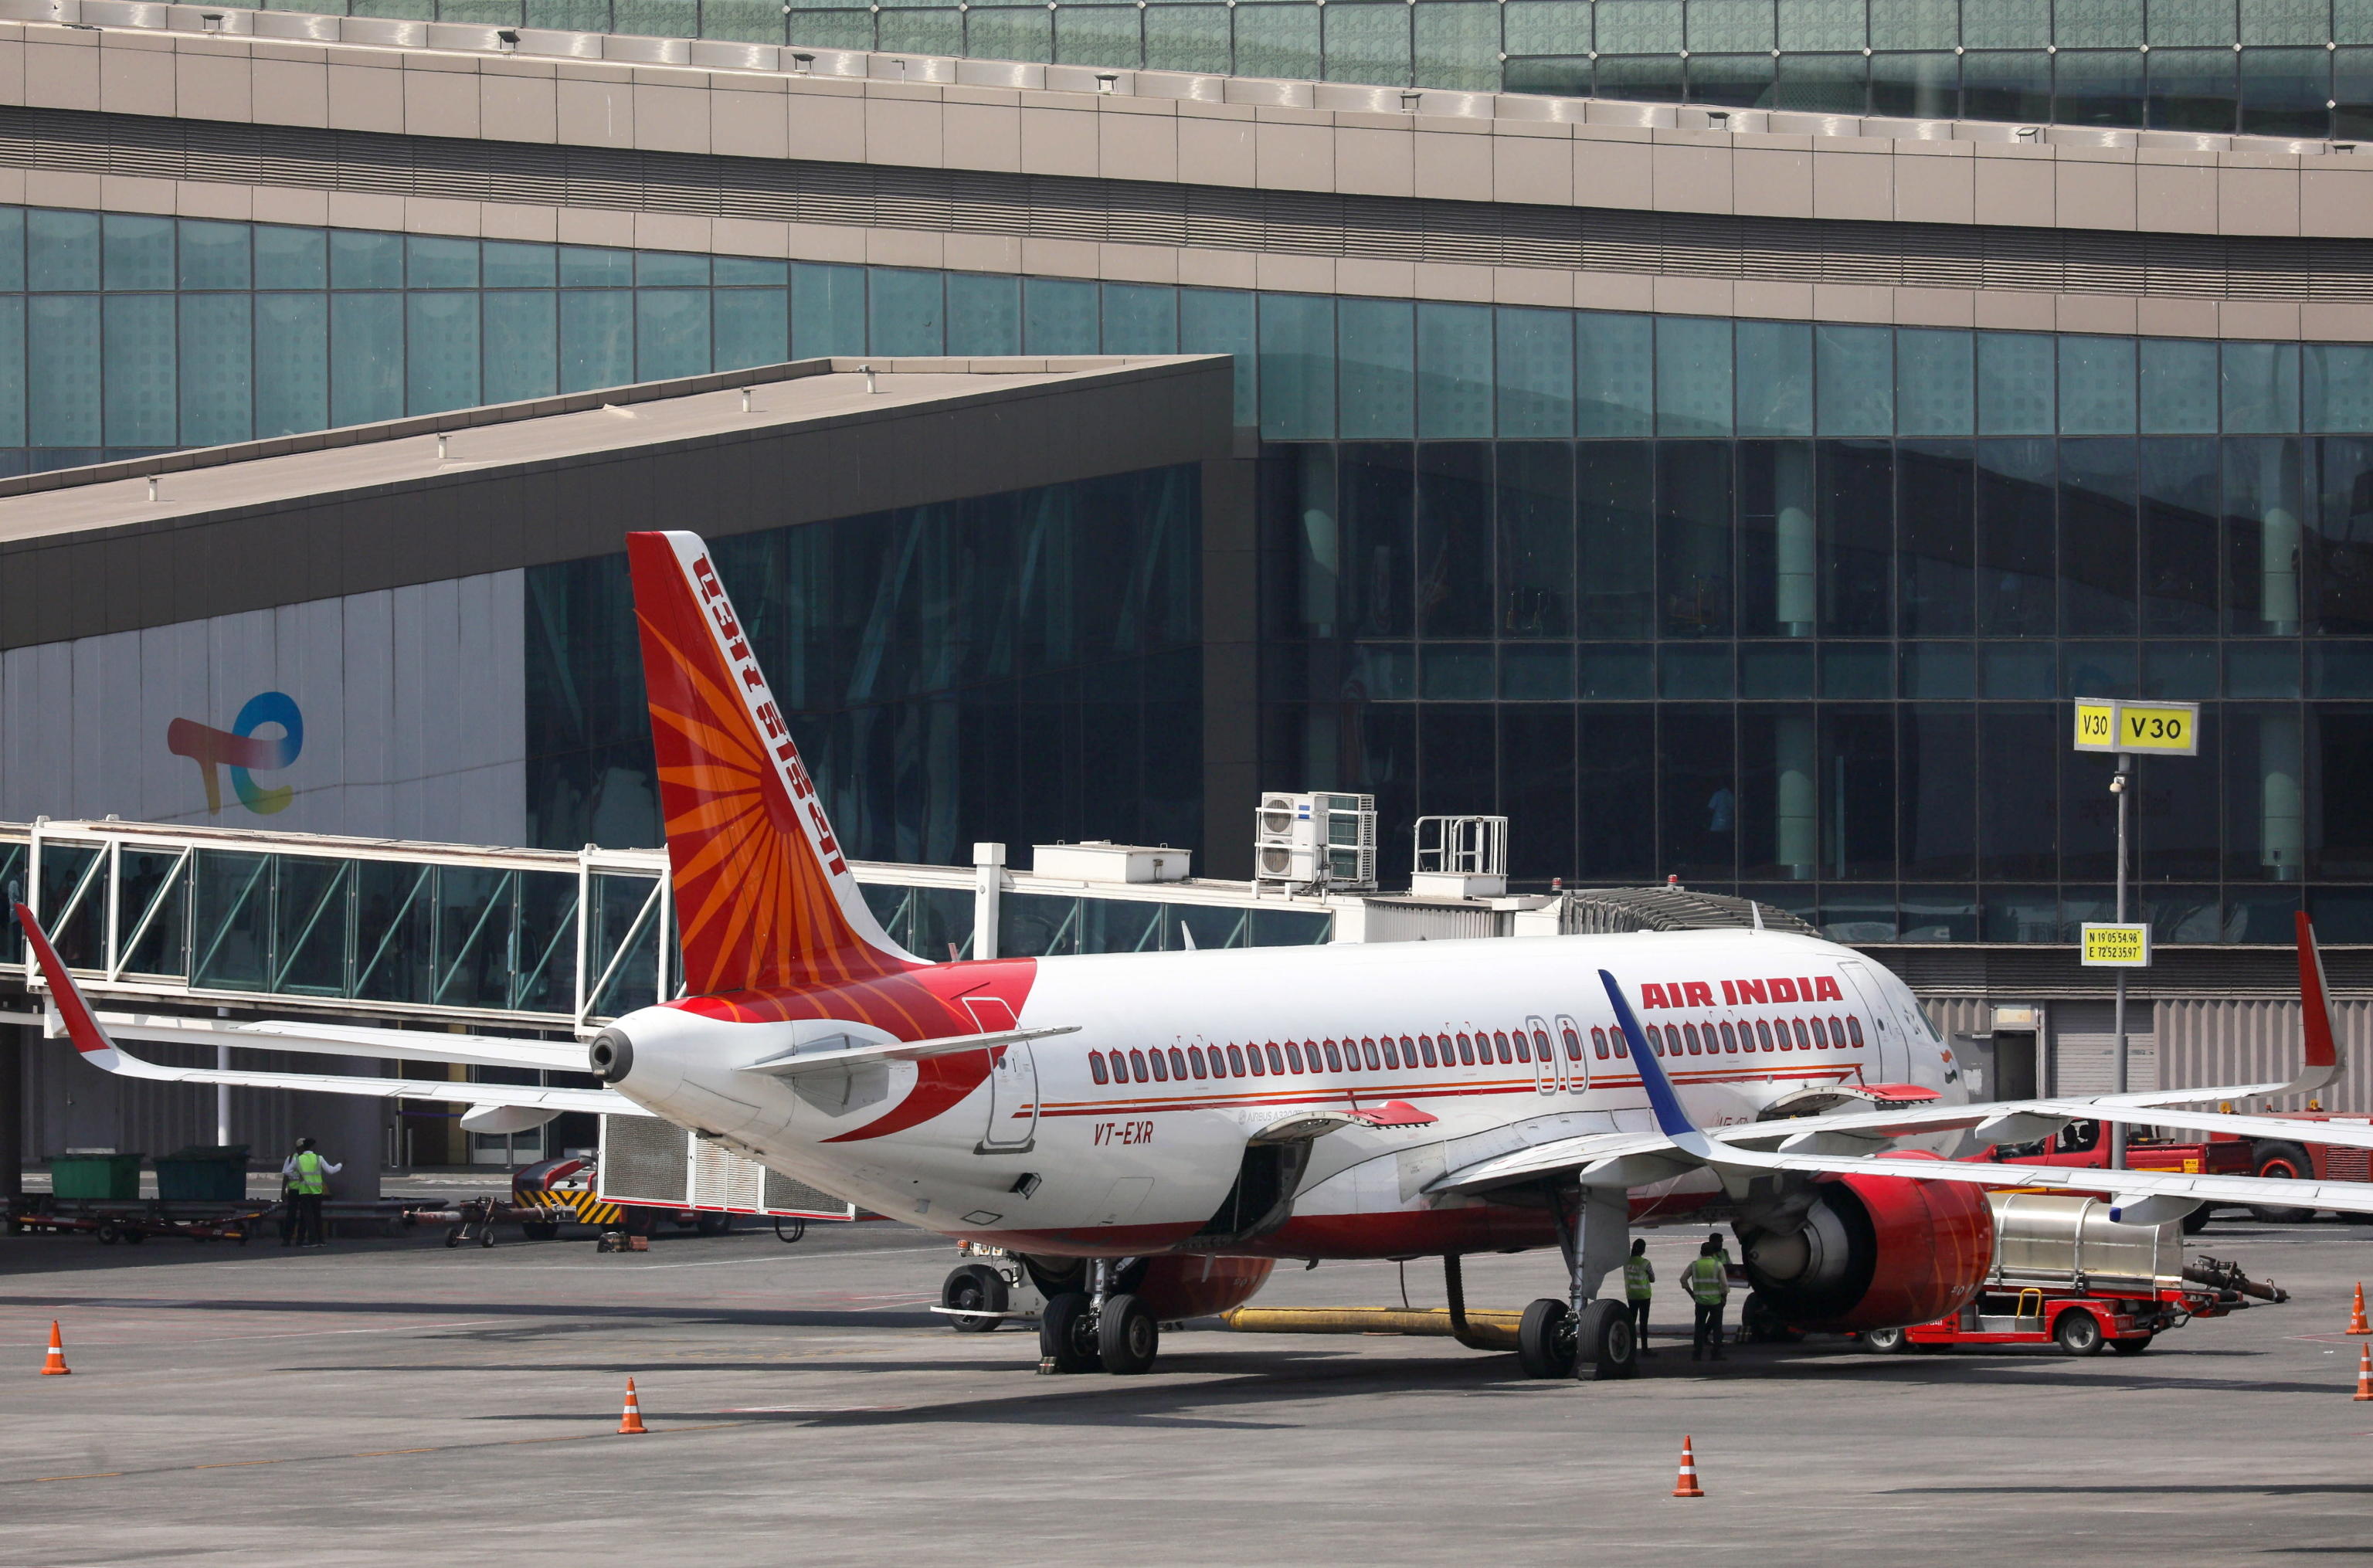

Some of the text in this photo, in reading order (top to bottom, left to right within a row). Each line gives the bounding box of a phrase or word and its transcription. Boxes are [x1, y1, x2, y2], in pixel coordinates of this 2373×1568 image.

[2083, 714, 2108, 735] V30
[2130, 717, 2181, 739] V30
[756, 700, 849, 877] इंडिया
[2090, 932, 2095, 942] N
[2090, 947, 2094, 957] E
[1641, 976, 1844, 1010] AIR INDIA
[1248, 1112, 1272, 1122] AIRBUS
[1094, 1121, 1153, 1145] VT-EXR
